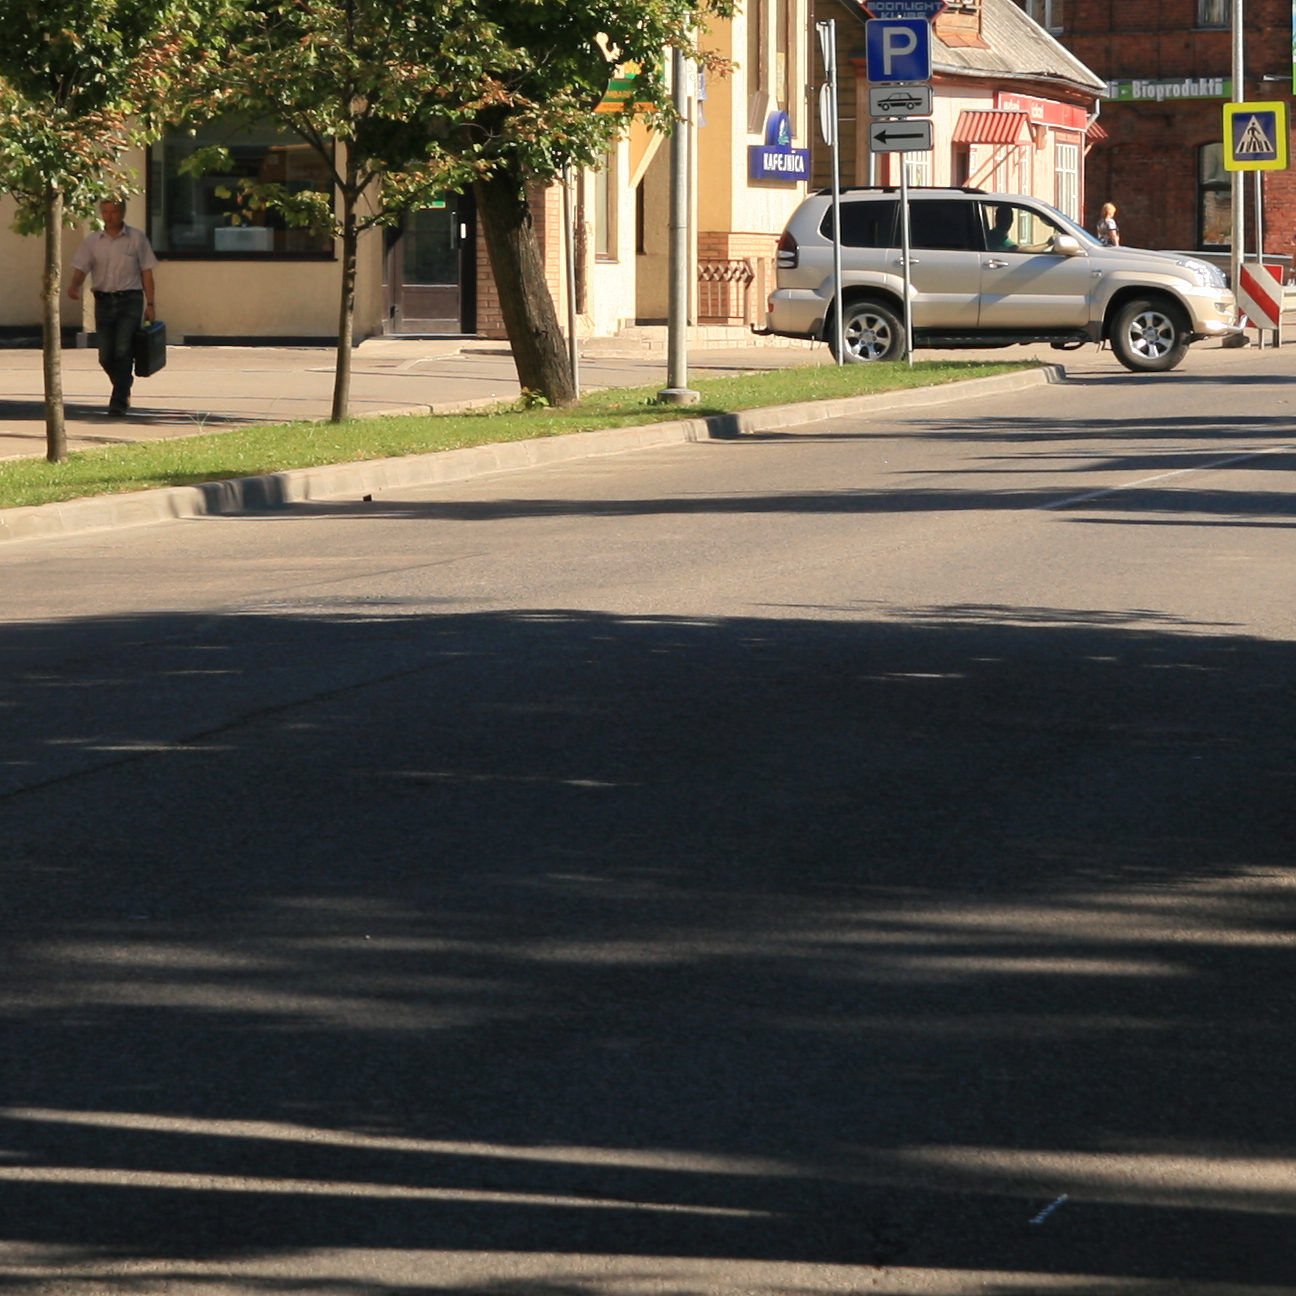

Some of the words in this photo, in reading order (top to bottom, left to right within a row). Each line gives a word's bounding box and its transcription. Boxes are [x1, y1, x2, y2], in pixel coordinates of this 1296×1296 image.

[883, 26, 918, 76] P
[1132, 78, 1223, 102] Bioprodukti
[763, 150, 805, 173] KAFEJNĪCA
